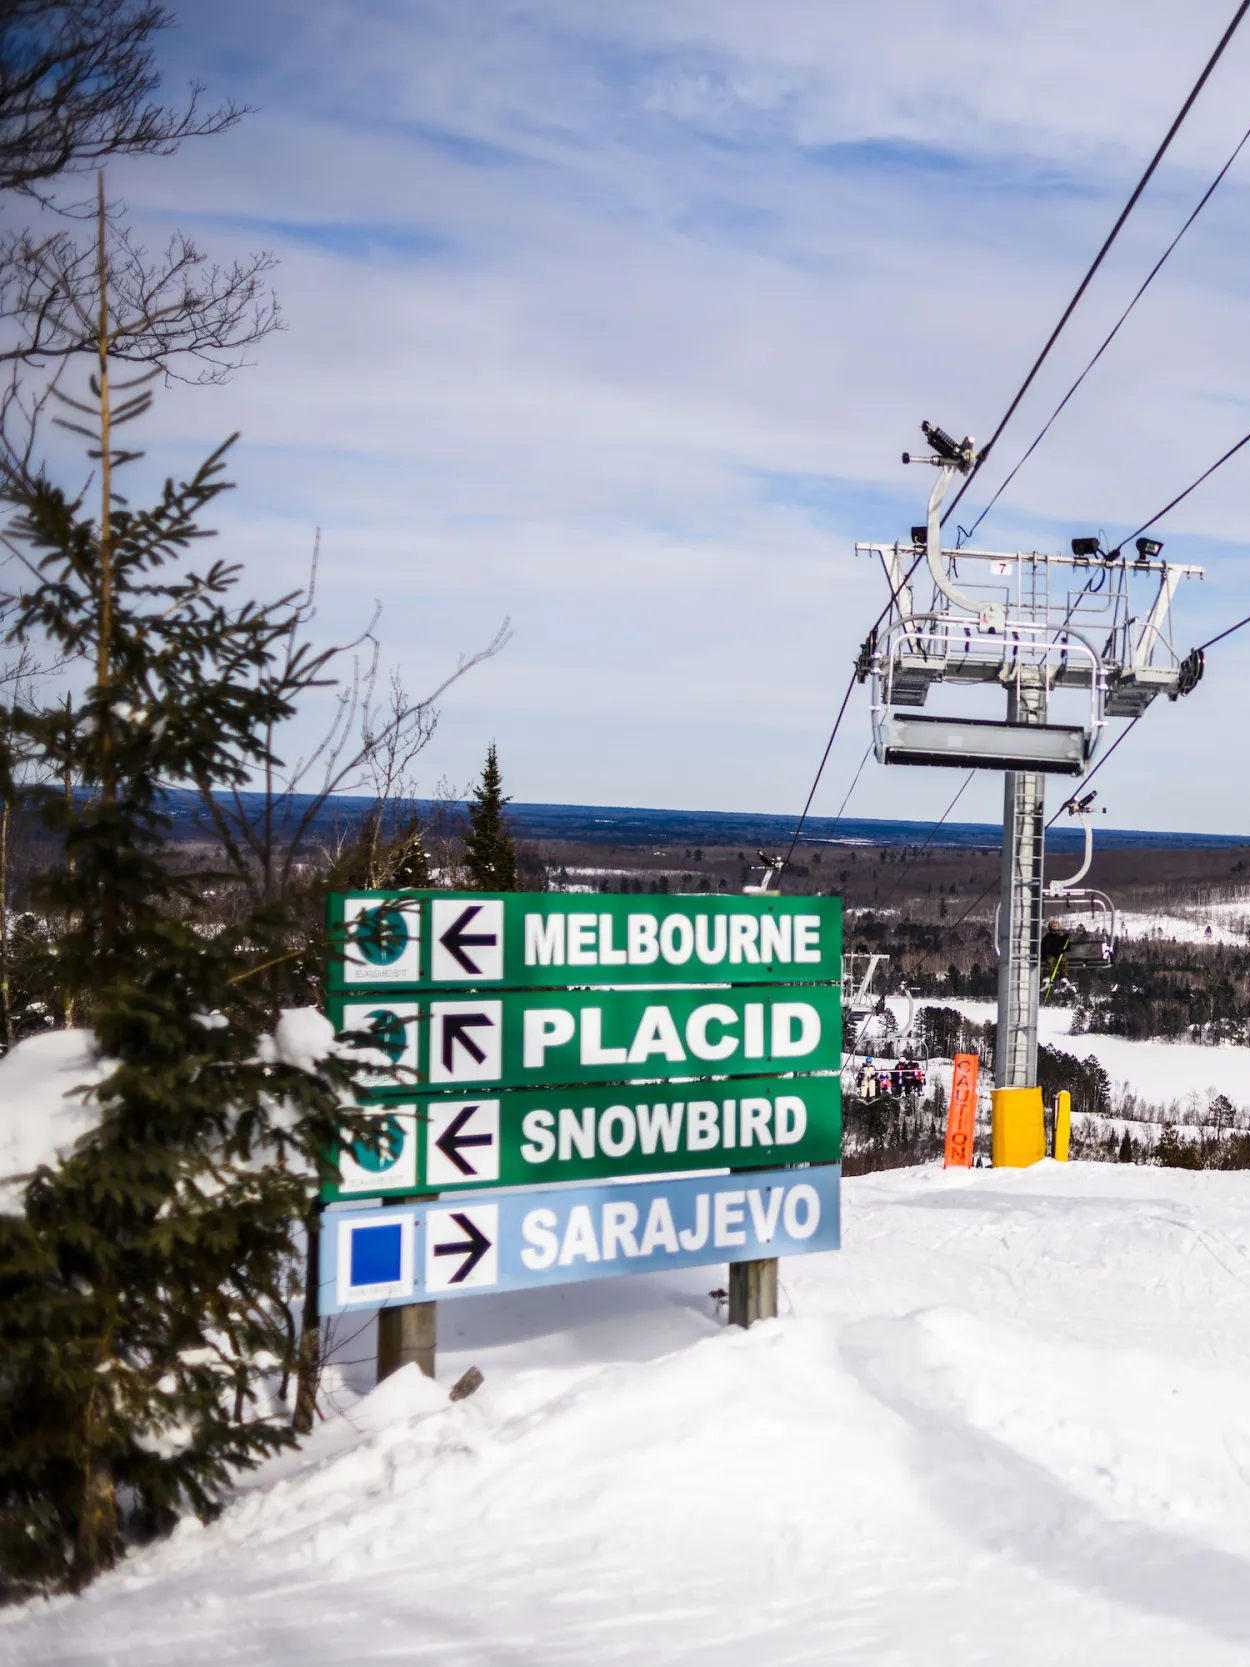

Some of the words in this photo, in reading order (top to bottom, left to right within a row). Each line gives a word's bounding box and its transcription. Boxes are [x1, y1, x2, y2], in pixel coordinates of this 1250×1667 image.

[999, 563, 1007, 574] 7
[524, 913, 822, 966] MELBOURNE
[523, 1002, 822, 1068] PLACID
[520, 1095, 808, 1164] SNOWBIRD
[951, 1060, 972, 1160] CAUTION
[519, 1184, 821, 1271] SARAJEVO
